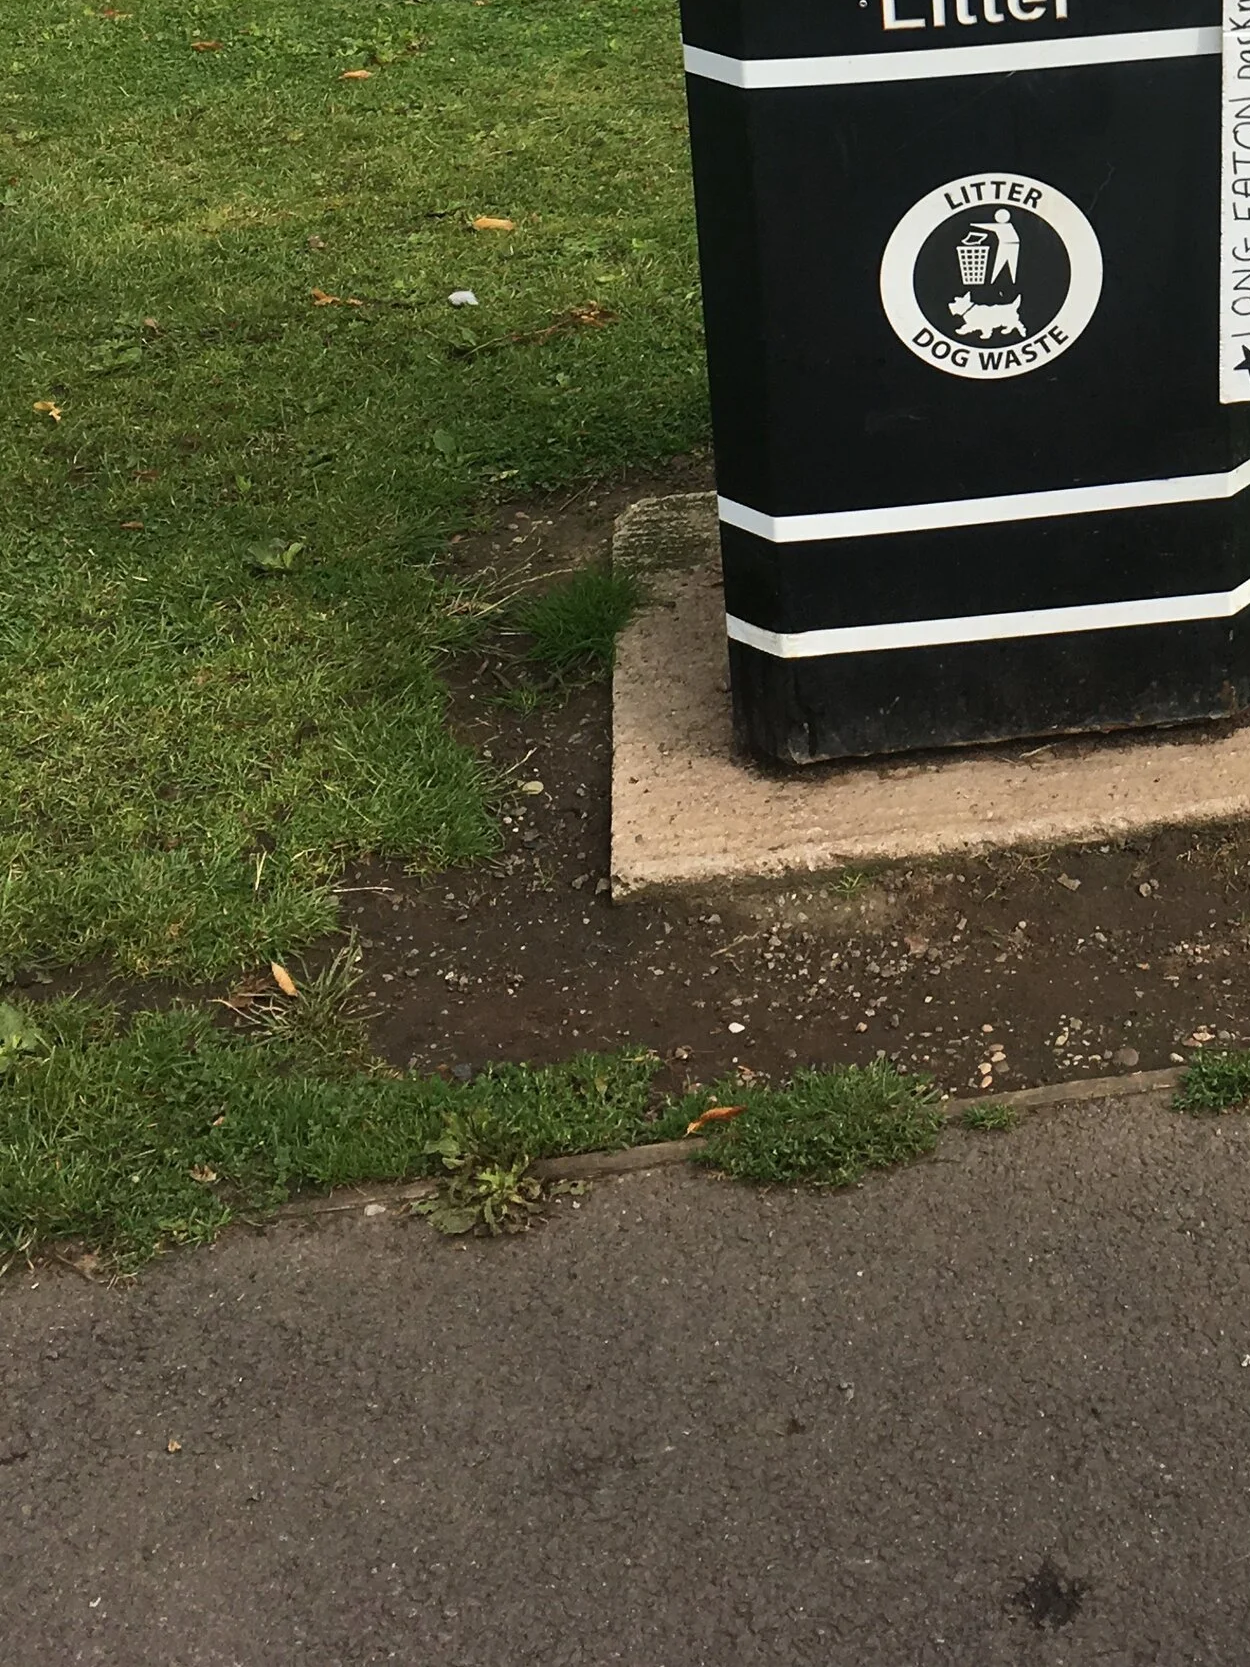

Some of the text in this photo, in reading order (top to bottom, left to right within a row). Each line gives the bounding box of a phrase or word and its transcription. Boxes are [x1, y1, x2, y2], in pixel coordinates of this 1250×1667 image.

[943, 180, 1043, 211] LITTER
[911, 325, 1069, 371] DOG WASTE
